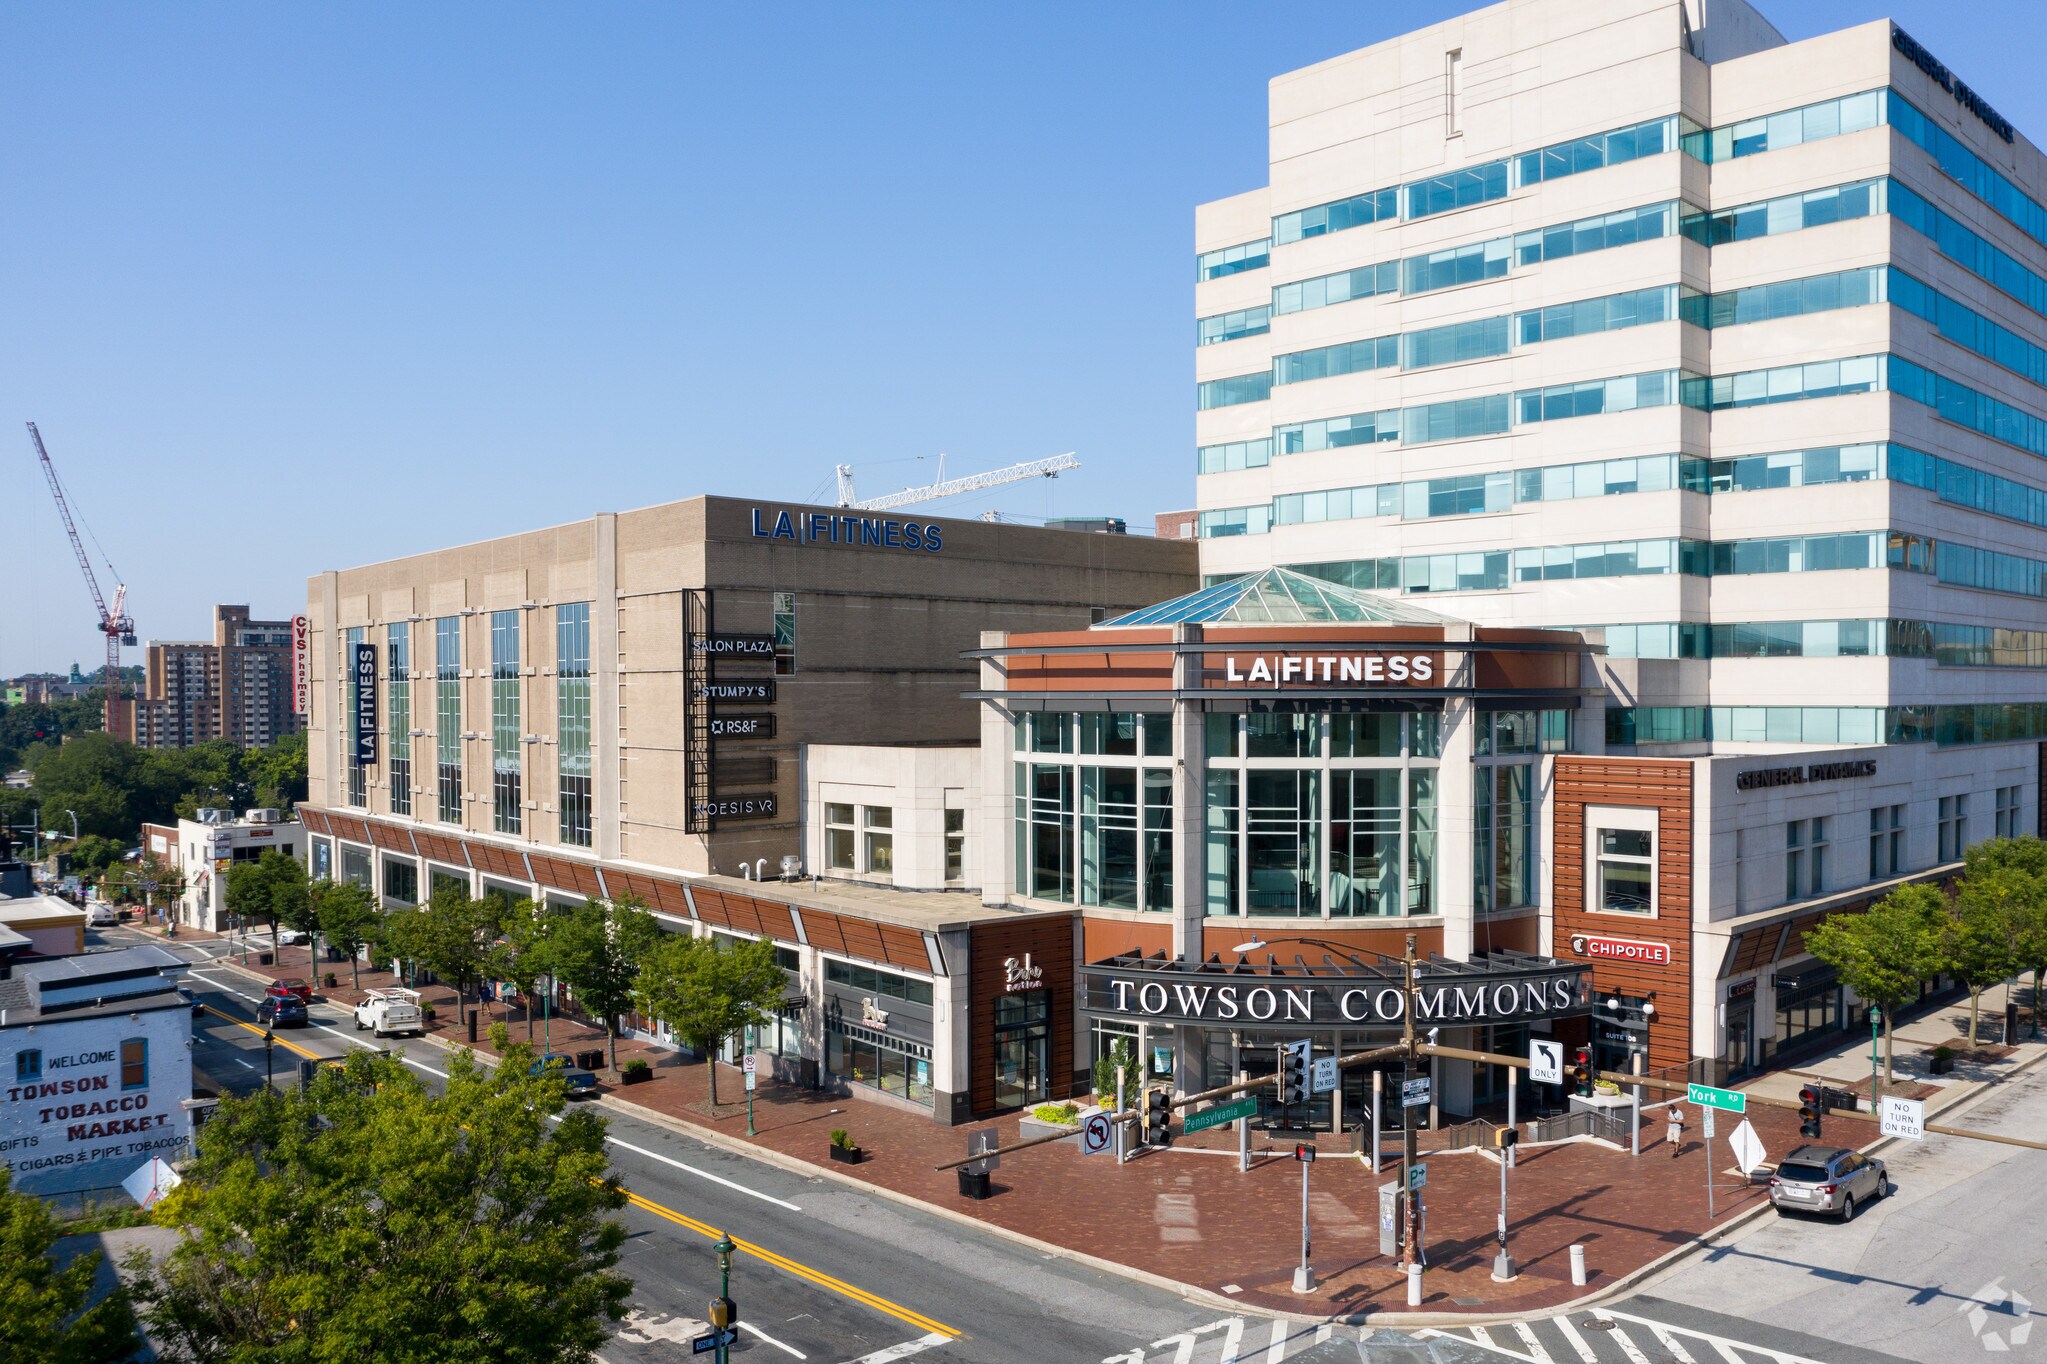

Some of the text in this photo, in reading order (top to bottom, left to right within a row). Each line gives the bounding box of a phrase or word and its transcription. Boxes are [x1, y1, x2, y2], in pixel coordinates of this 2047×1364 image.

[752, 507, 944, 552] LA FITNESS
[296, 616, 307, 650] CVS
[693, 640, 773, 653] SALON PLAZA
[1227, 655, 1433, 682] LA FITNESS
[297, 653, 307, 712] pharmacy
[702, 686, 766, 697] STUMPY'S
[359, 650, 375, 759] LA FITNESS
[726, 720, 758, 733] RS&F
[1737, 759, 1877, 790] GENERAL DYNAMICS
[694, 800, 773, 816] NOESIS VR
[1589, 942, 1663, 961] CHIPOTLE
[1111, 978, 1572, 1021] TOWSON COMMONS
[1605, 1032, 1624, 1040] SUITE
[49, 1050, 116, 1070] WELCOME
[1321, 1061, 1331, 1069] NO
[1318, 1070, 1333, 1078] TURN
[1534, 1068, 1557, 1079] ONLY
[7, 1074, 109, 1102] TOWSON
[1315, 1078, 1335, 1088] ON RED
[1690, 1087, 1739, 1104] York RD
[39, 1093, 149, 1124] TOBACCO
[1894, 1103, 1910, 1113] NO
[1185, 1106, 1238, 1130] Pennsylvania
[1889, 1112, 1914, 1124] TURN
[67, 1113, 169, 1142] MARKET
[1884, 1122, 1919, 1136] ON RED
[0, 1136, 39, 1151] GIFTS
[20, 1153, 74, 1172] CIGARS
[91, 1145, 122, 1160] PIPE
[127, 1135, 190, 1152] TOBACCOS
[697, 1339, 711, 1349] ONE
